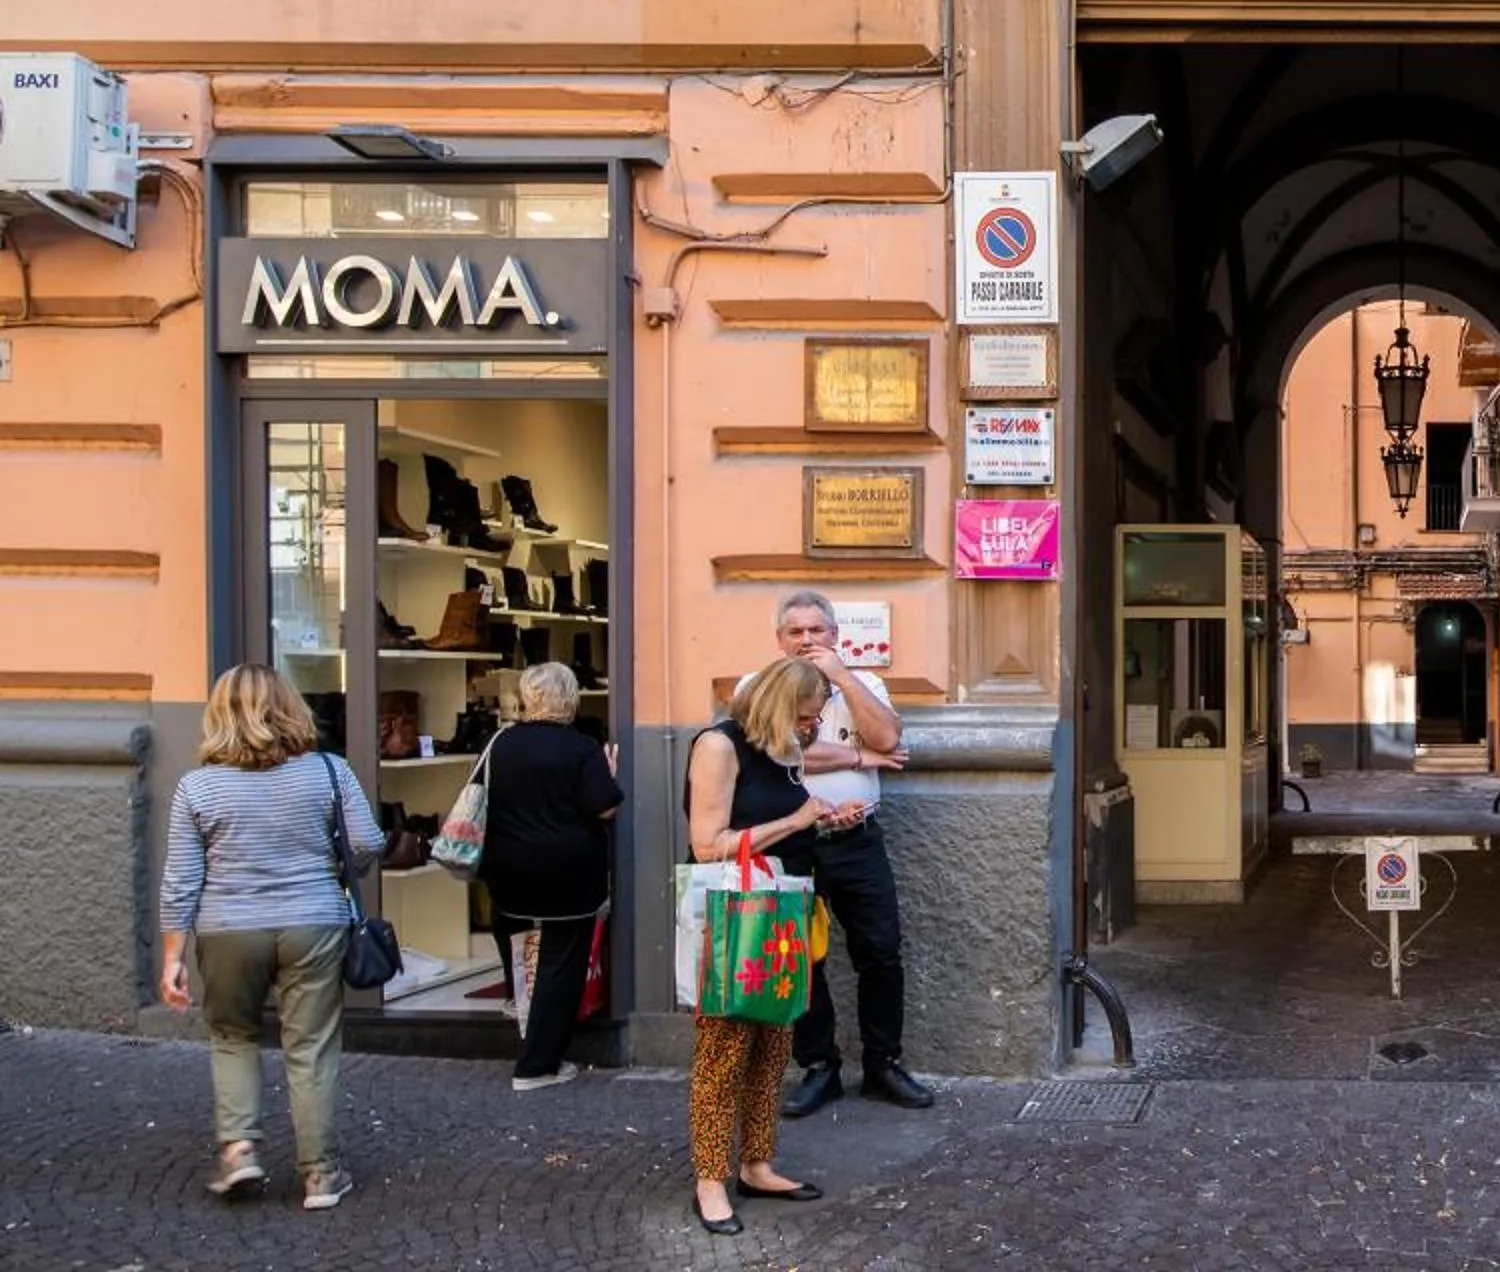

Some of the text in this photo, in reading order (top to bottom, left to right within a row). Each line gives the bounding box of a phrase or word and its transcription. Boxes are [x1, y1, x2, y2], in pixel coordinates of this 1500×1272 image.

[14, 73, 59, 88] BAXI
[241, 254, 561, 328] MOMA.
[971, 281, 1043, 301] PASSO CARRABILE
